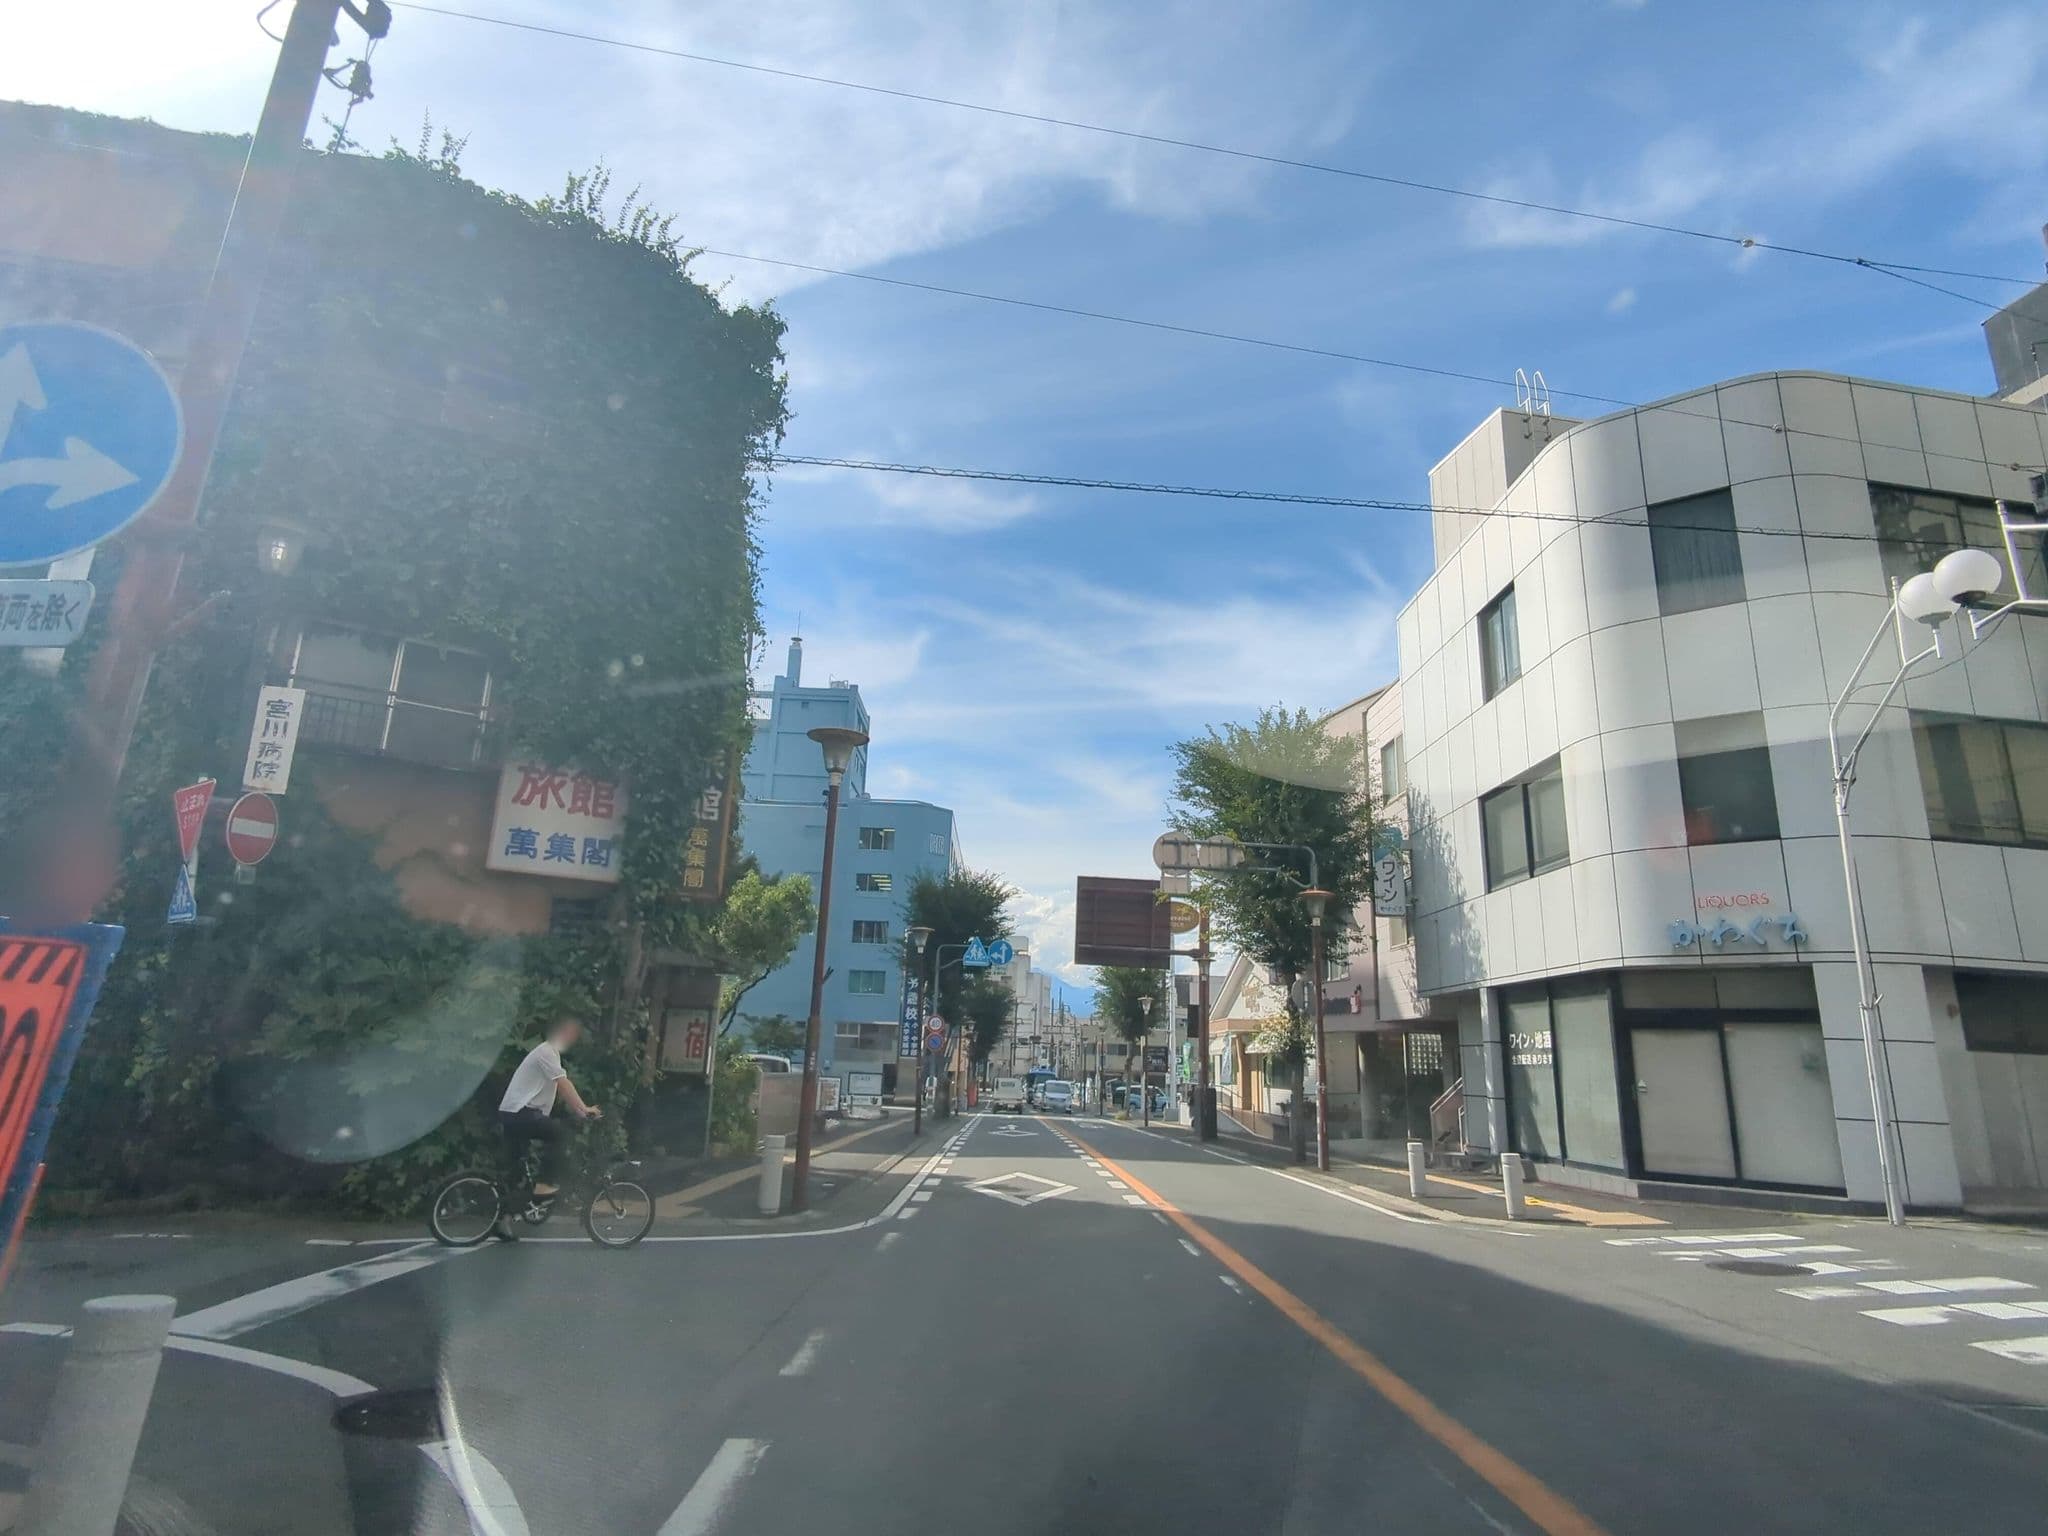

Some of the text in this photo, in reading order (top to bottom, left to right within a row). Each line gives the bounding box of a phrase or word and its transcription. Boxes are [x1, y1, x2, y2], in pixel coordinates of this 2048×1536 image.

[252, 699, 293, 780] 宮川病院
[511, 763, 618, 819] 旅館
[504, 827, 612, 868] 萬集閣
[1382, 861, 1398, 903] ワイン
[1697, 893, 1770, 909] LIQUORS
[1509, 1030, 1552, 1049] ワイン・地酒
